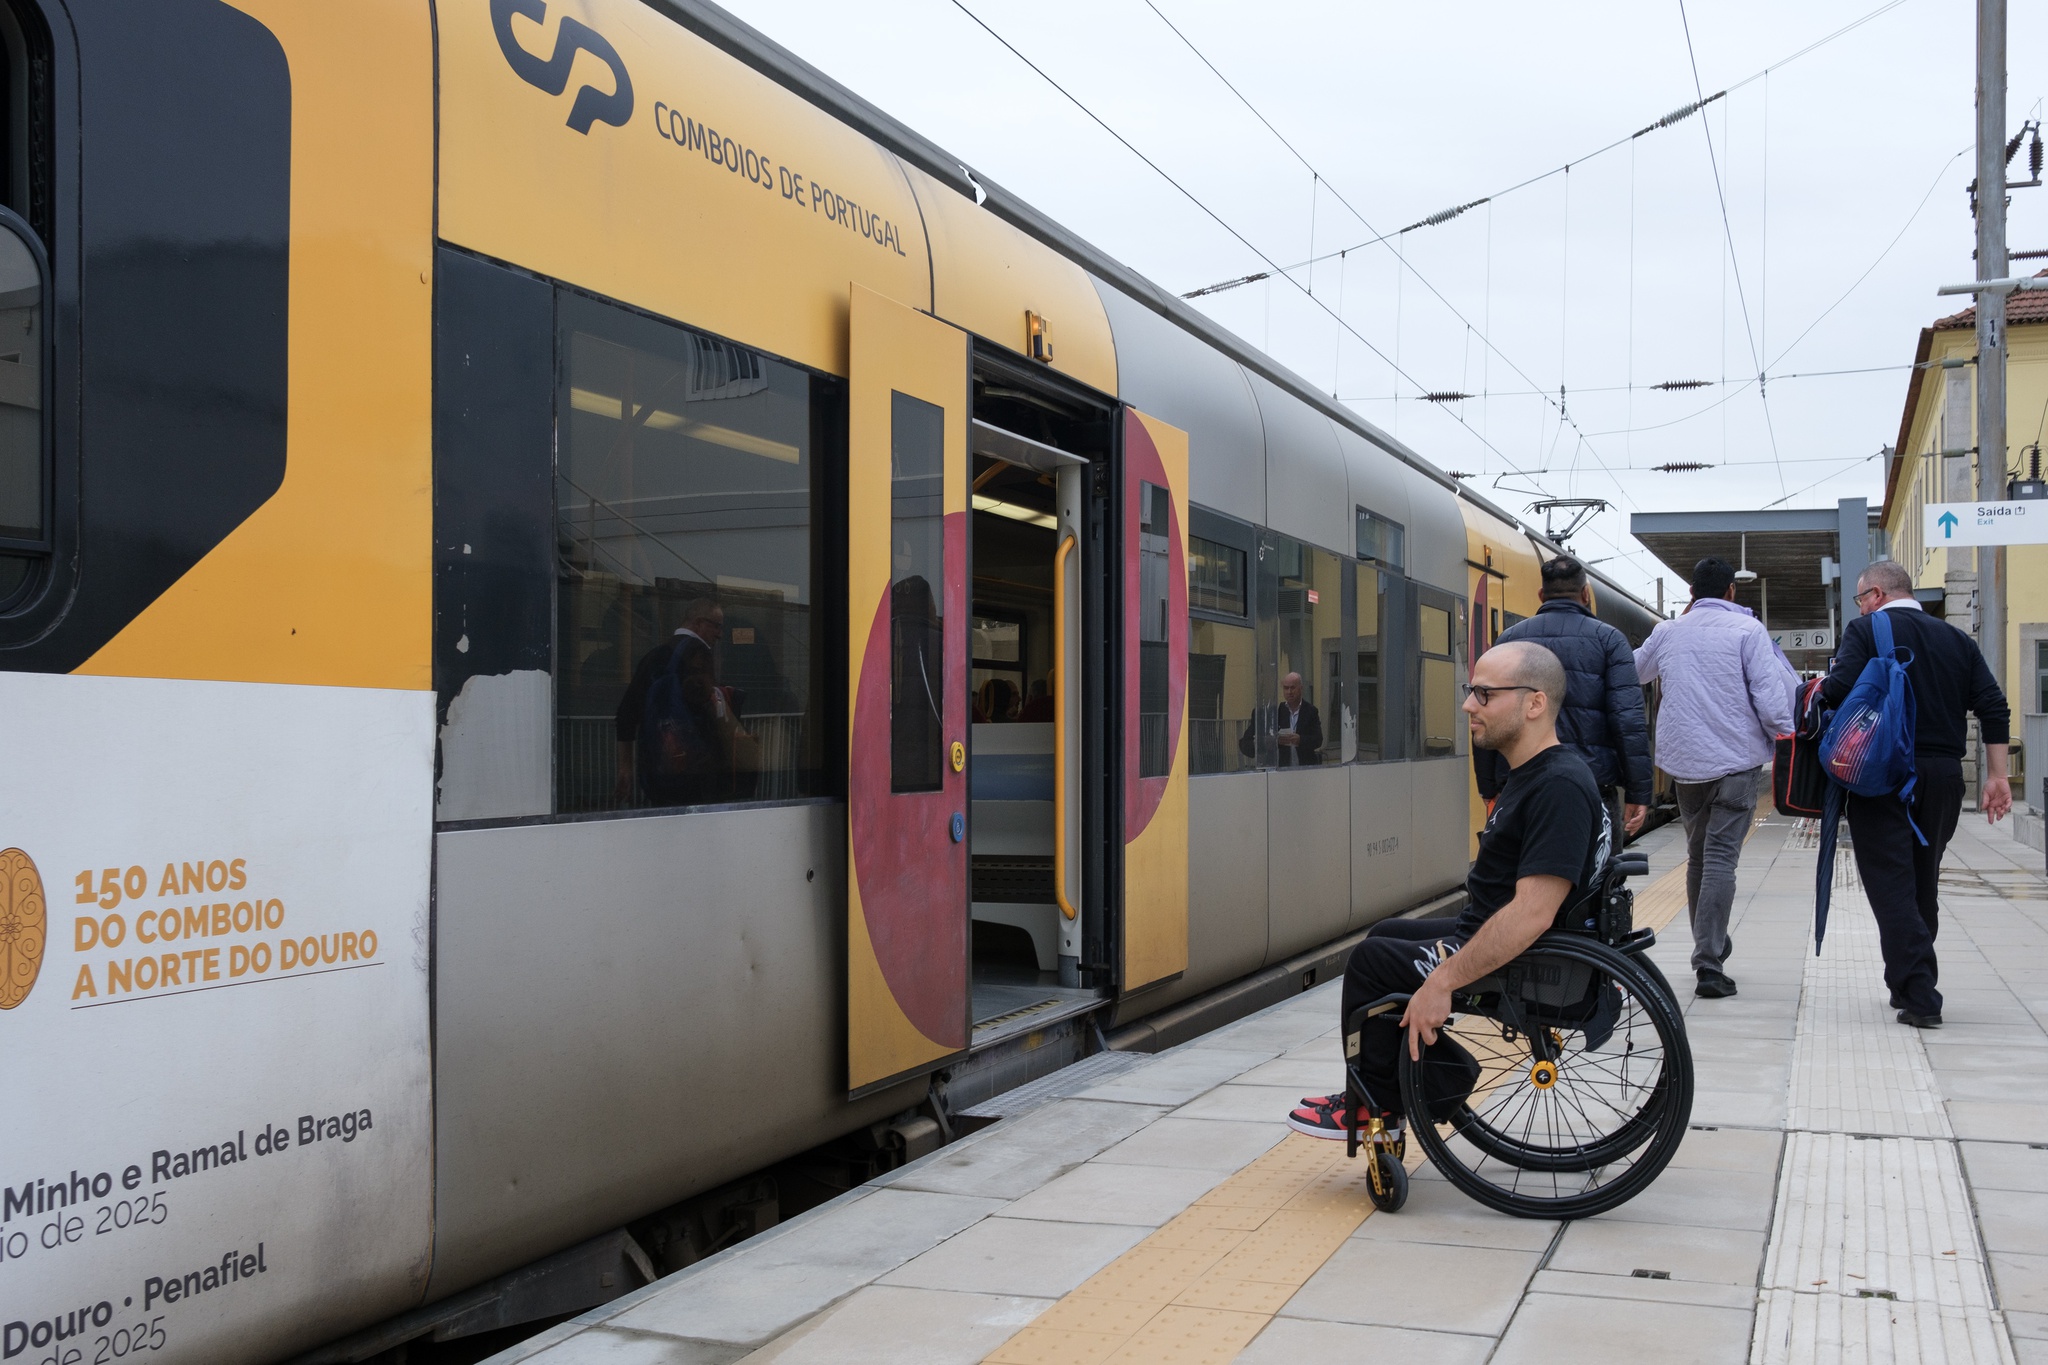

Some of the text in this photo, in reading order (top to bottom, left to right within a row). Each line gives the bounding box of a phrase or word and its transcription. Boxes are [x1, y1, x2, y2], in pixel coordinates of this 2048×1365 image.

[654, 100, 906, 257] COMBOIOS DE PORTUGAL
[1977, 506, 2012, 517] Saída
[1977, 518, 1994, 526] Exit
[1795, 637, 1802, 646] 2
[1815, 635, 1824, 645] D
[75, 858, 247, 910] 150 ANOS
[74, 898, 285, 952] DO COMBOIO
[71, 929, 378, 1000] A NORTE DO DOURO
[3, 1108, 373, 1222] Minho e Ramal de Braga
[41, 1211, 85, 1250] de
[95, 1190, 168, 1236] 2025
[2, 1242, 267, 1360] Douro Penafiel
[93, 1315, 167, 1365] 2025
